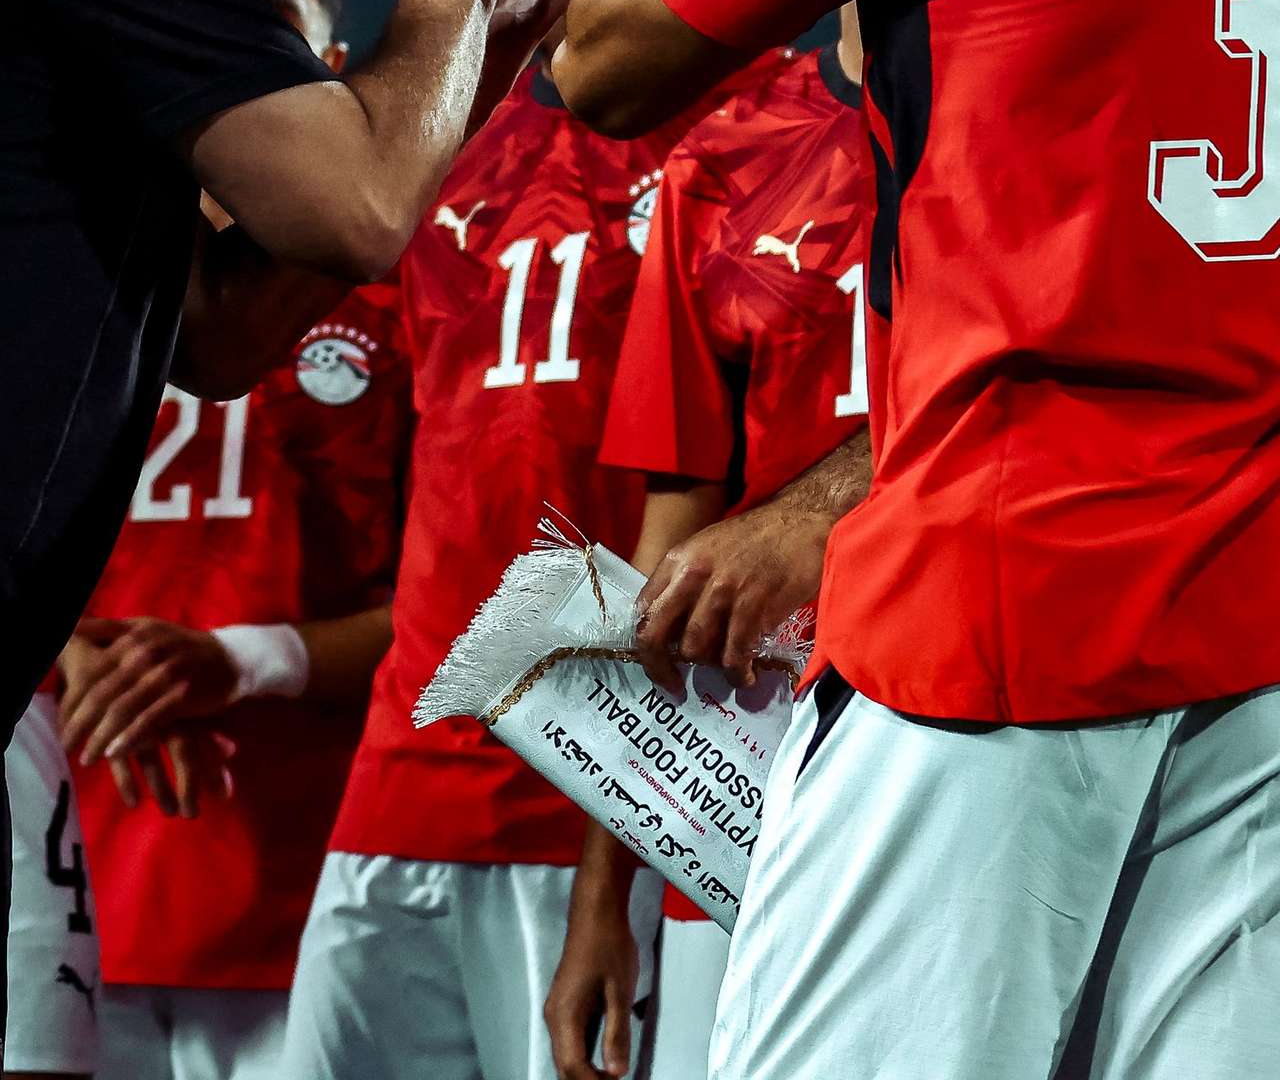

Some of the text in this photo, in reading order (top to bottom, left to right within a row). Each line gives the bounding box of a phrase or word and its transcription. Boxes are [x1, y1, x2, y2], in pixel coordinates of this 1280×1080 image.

[483, 230, 591, 389] 11
[131, 382, 253, 522] 21
[541, 720, 603, 776] الاتحاد
[597, 775, 663, 831] المصري
[655, 833, 701, 877] لكرة
[586, 678, 759, 858] YPTIAN FOOTBALL
[627, 759, 706, 836] WITH THE COMPLEMENTS OF
[45, 779, 92, 934] 4
